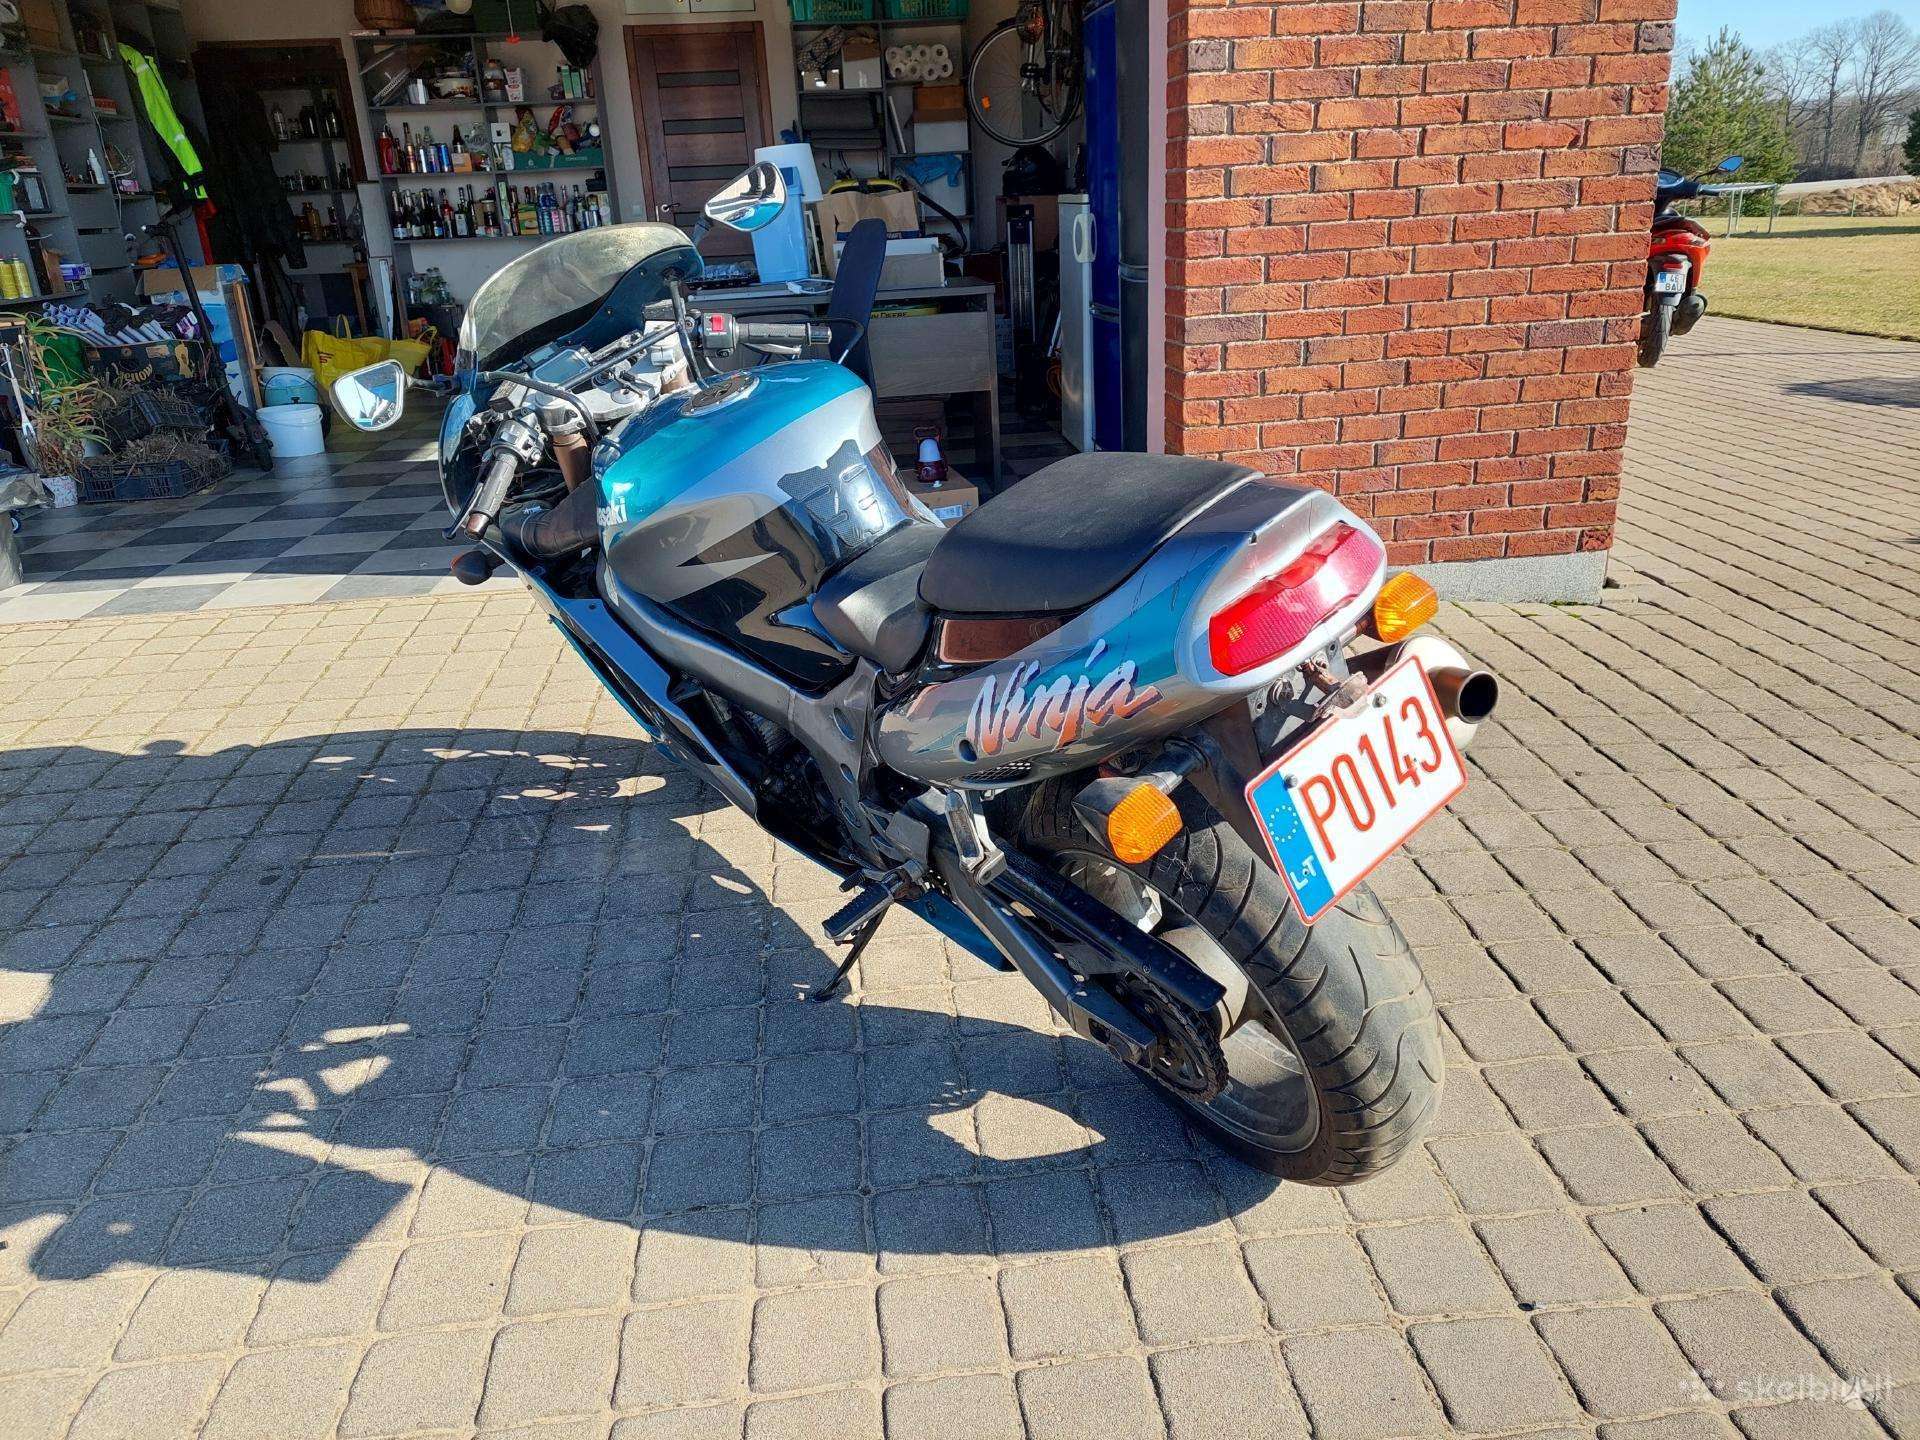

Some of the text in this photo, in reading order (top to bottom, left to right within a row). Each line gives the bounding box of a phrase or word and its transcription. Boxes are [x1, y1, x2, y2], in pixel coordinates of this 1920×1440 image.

[966, 638, 1164, 756] Ninja
[1299, 695, 1443, 863] P0143
[1289, 854, 1319, 891] LT
